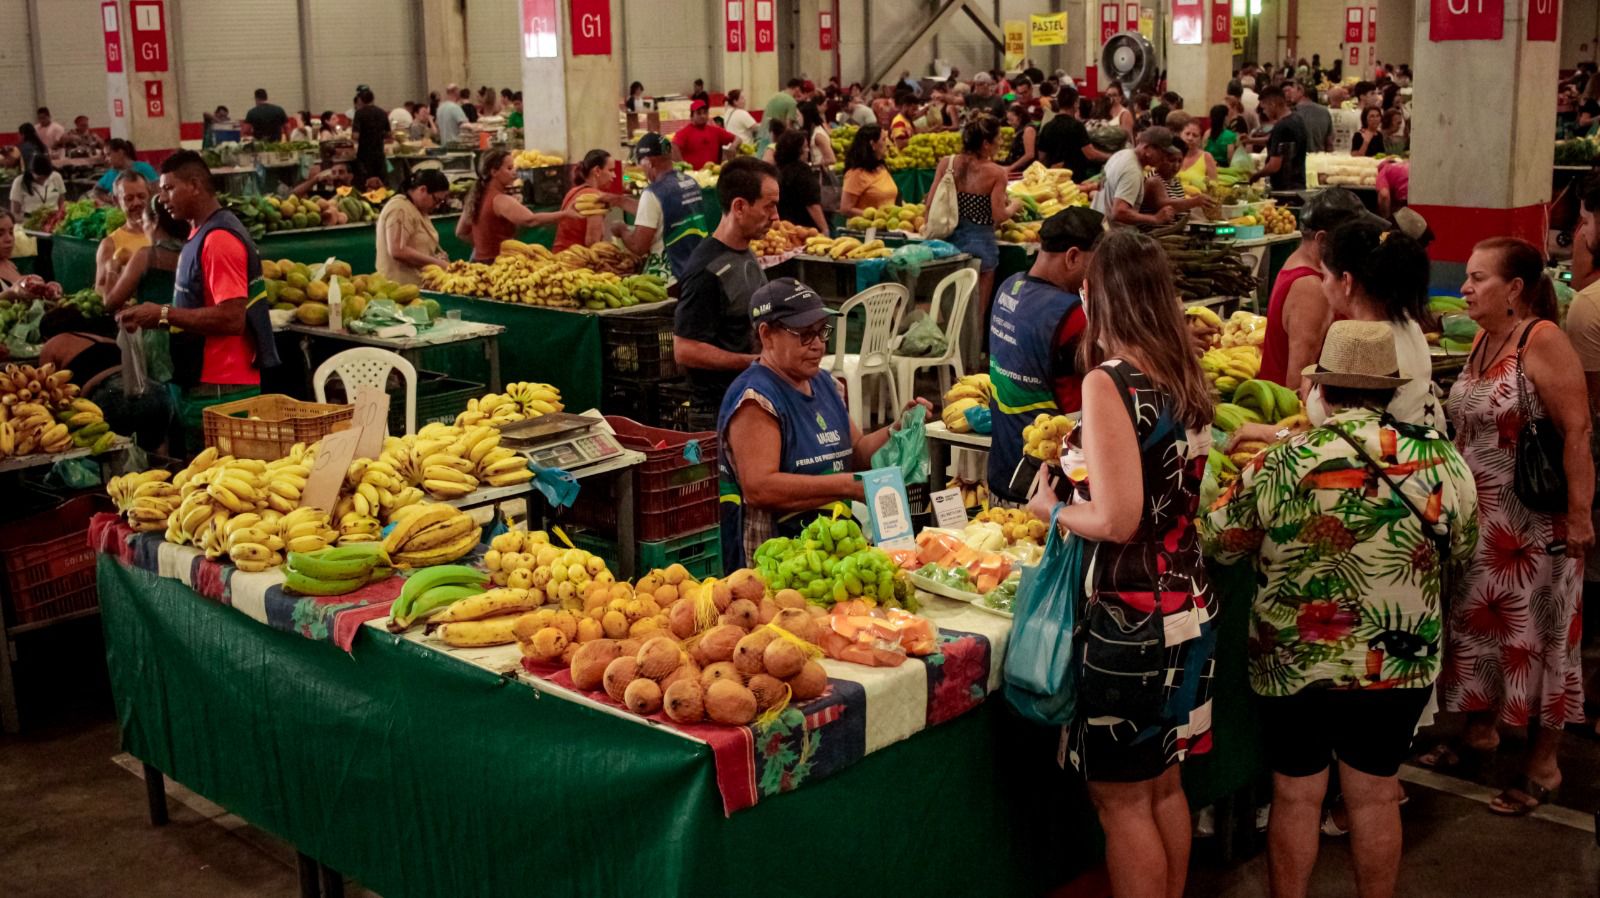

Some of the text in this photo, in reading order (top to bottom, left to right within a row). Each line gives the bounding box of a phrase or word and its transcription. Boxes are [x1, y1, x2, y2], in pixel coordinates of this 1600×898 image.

[580, 12, 602, 39] G1
[1032, 20, 1064, 32] PASTEL
[1216, 14, 1227, 32] G1
[758, 28, 772, 44] G1
[107, 42, 120, 61] G1
[140, 41, 161, 61] G1
[795, 455, 823, 467] FEIRA DE
